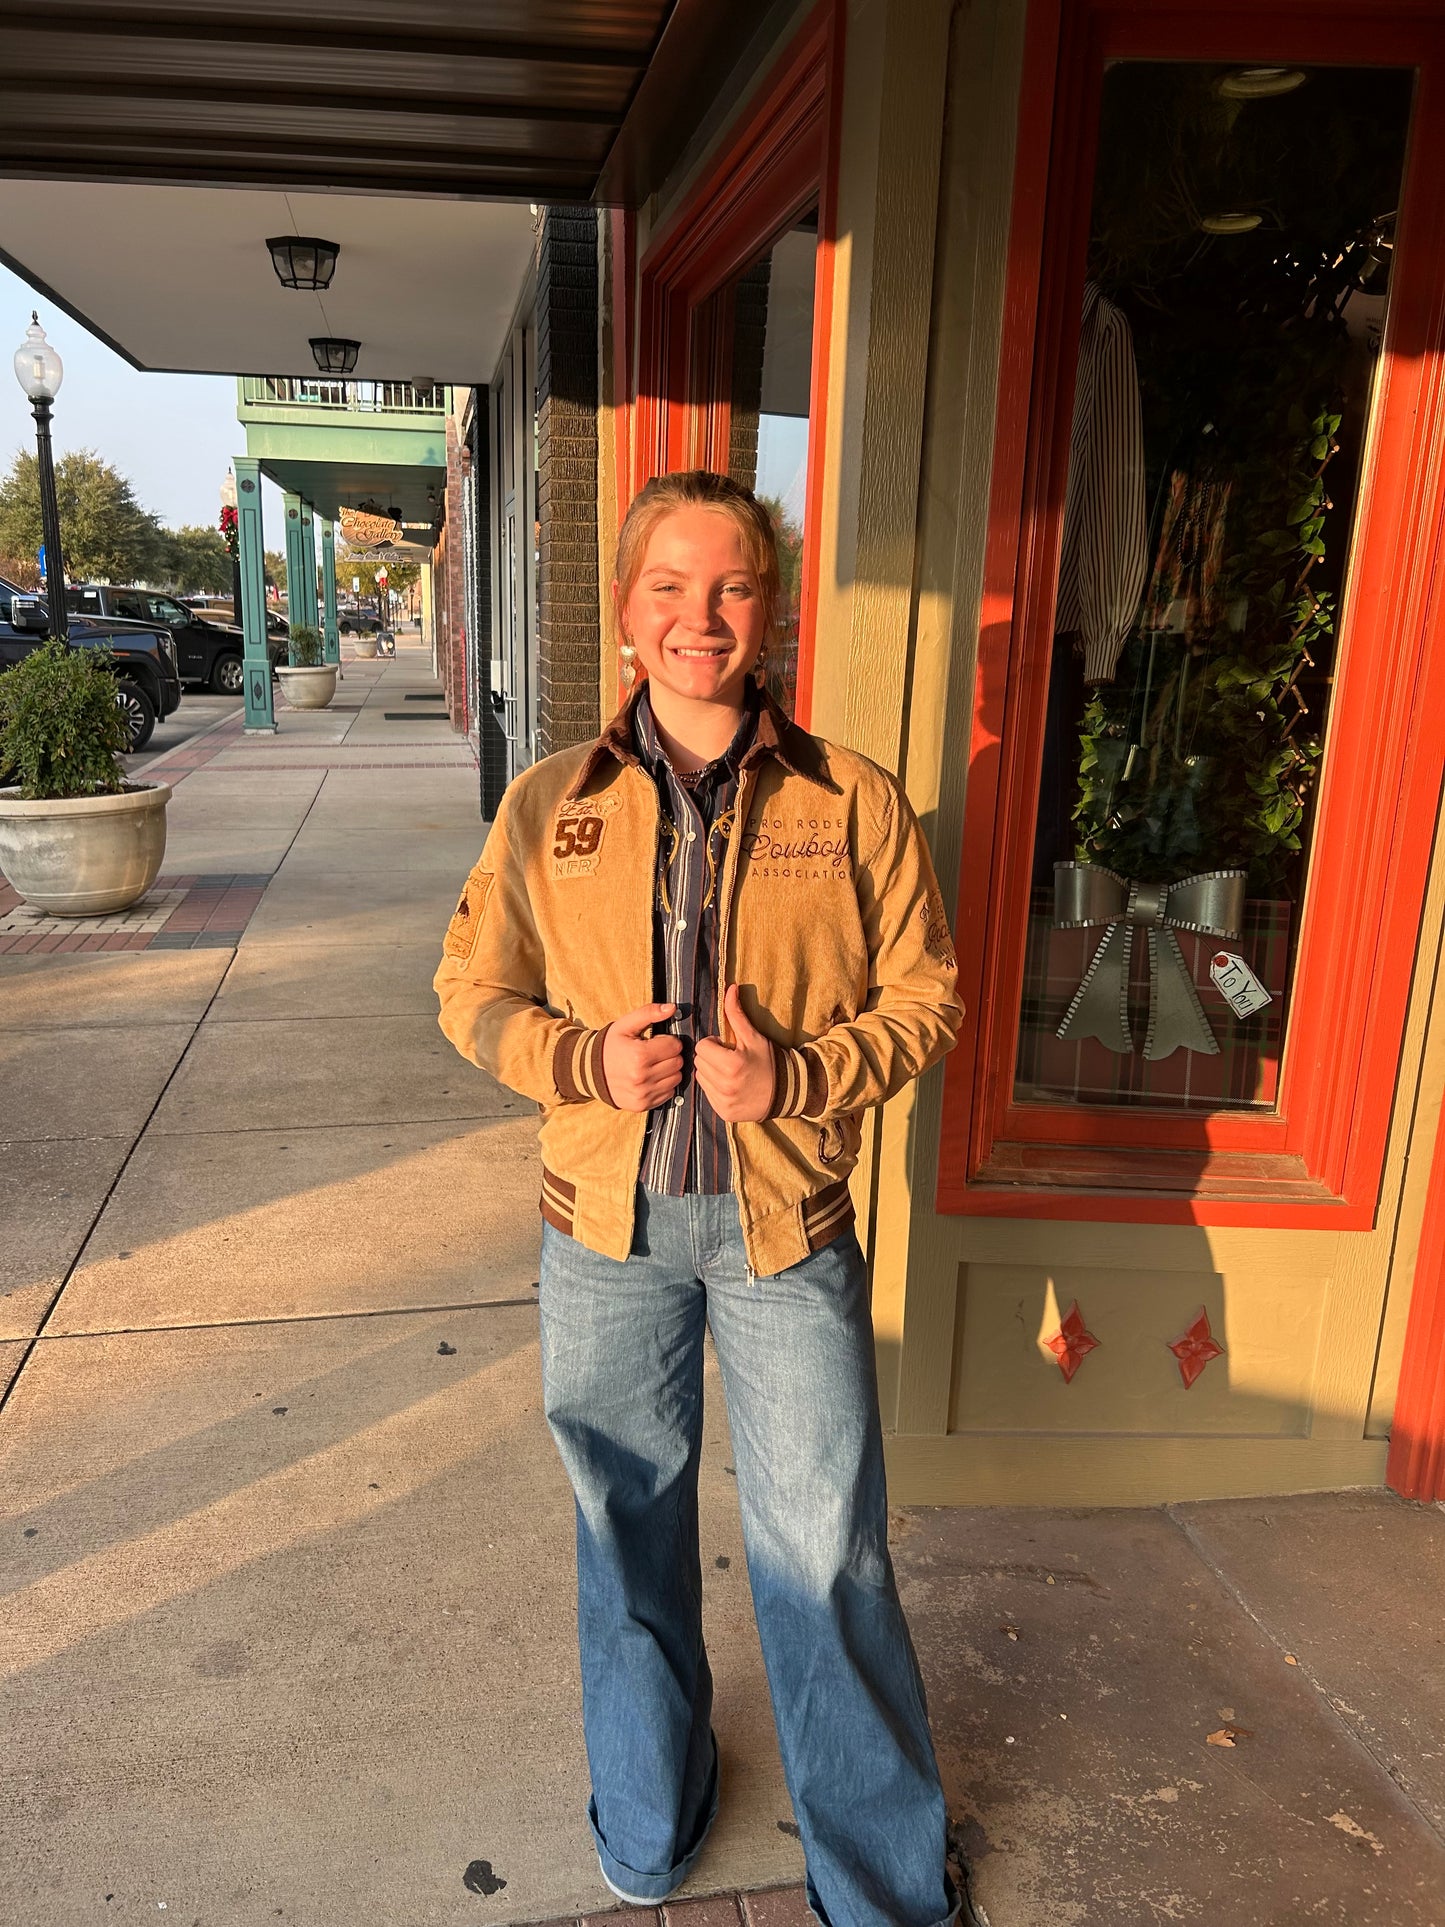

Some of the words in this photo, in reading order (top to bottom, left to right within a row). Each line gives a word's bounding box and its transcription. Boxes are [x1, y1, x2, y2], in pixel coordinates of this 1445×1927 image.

[341, 516, 394, 529] Chocolate
[356, 528, 403, 542] Gallery
[749, 818, 783, 829] PRO
[797, 818, 844, 829] RODE
[553, 816, 604, 859] 59
[740, 832, 851, 867] Cowboy
[555, 859, 592, 876] NFR
[1219, 960, 1243, 988] To
[1232, 980, 1257, 1010] You
